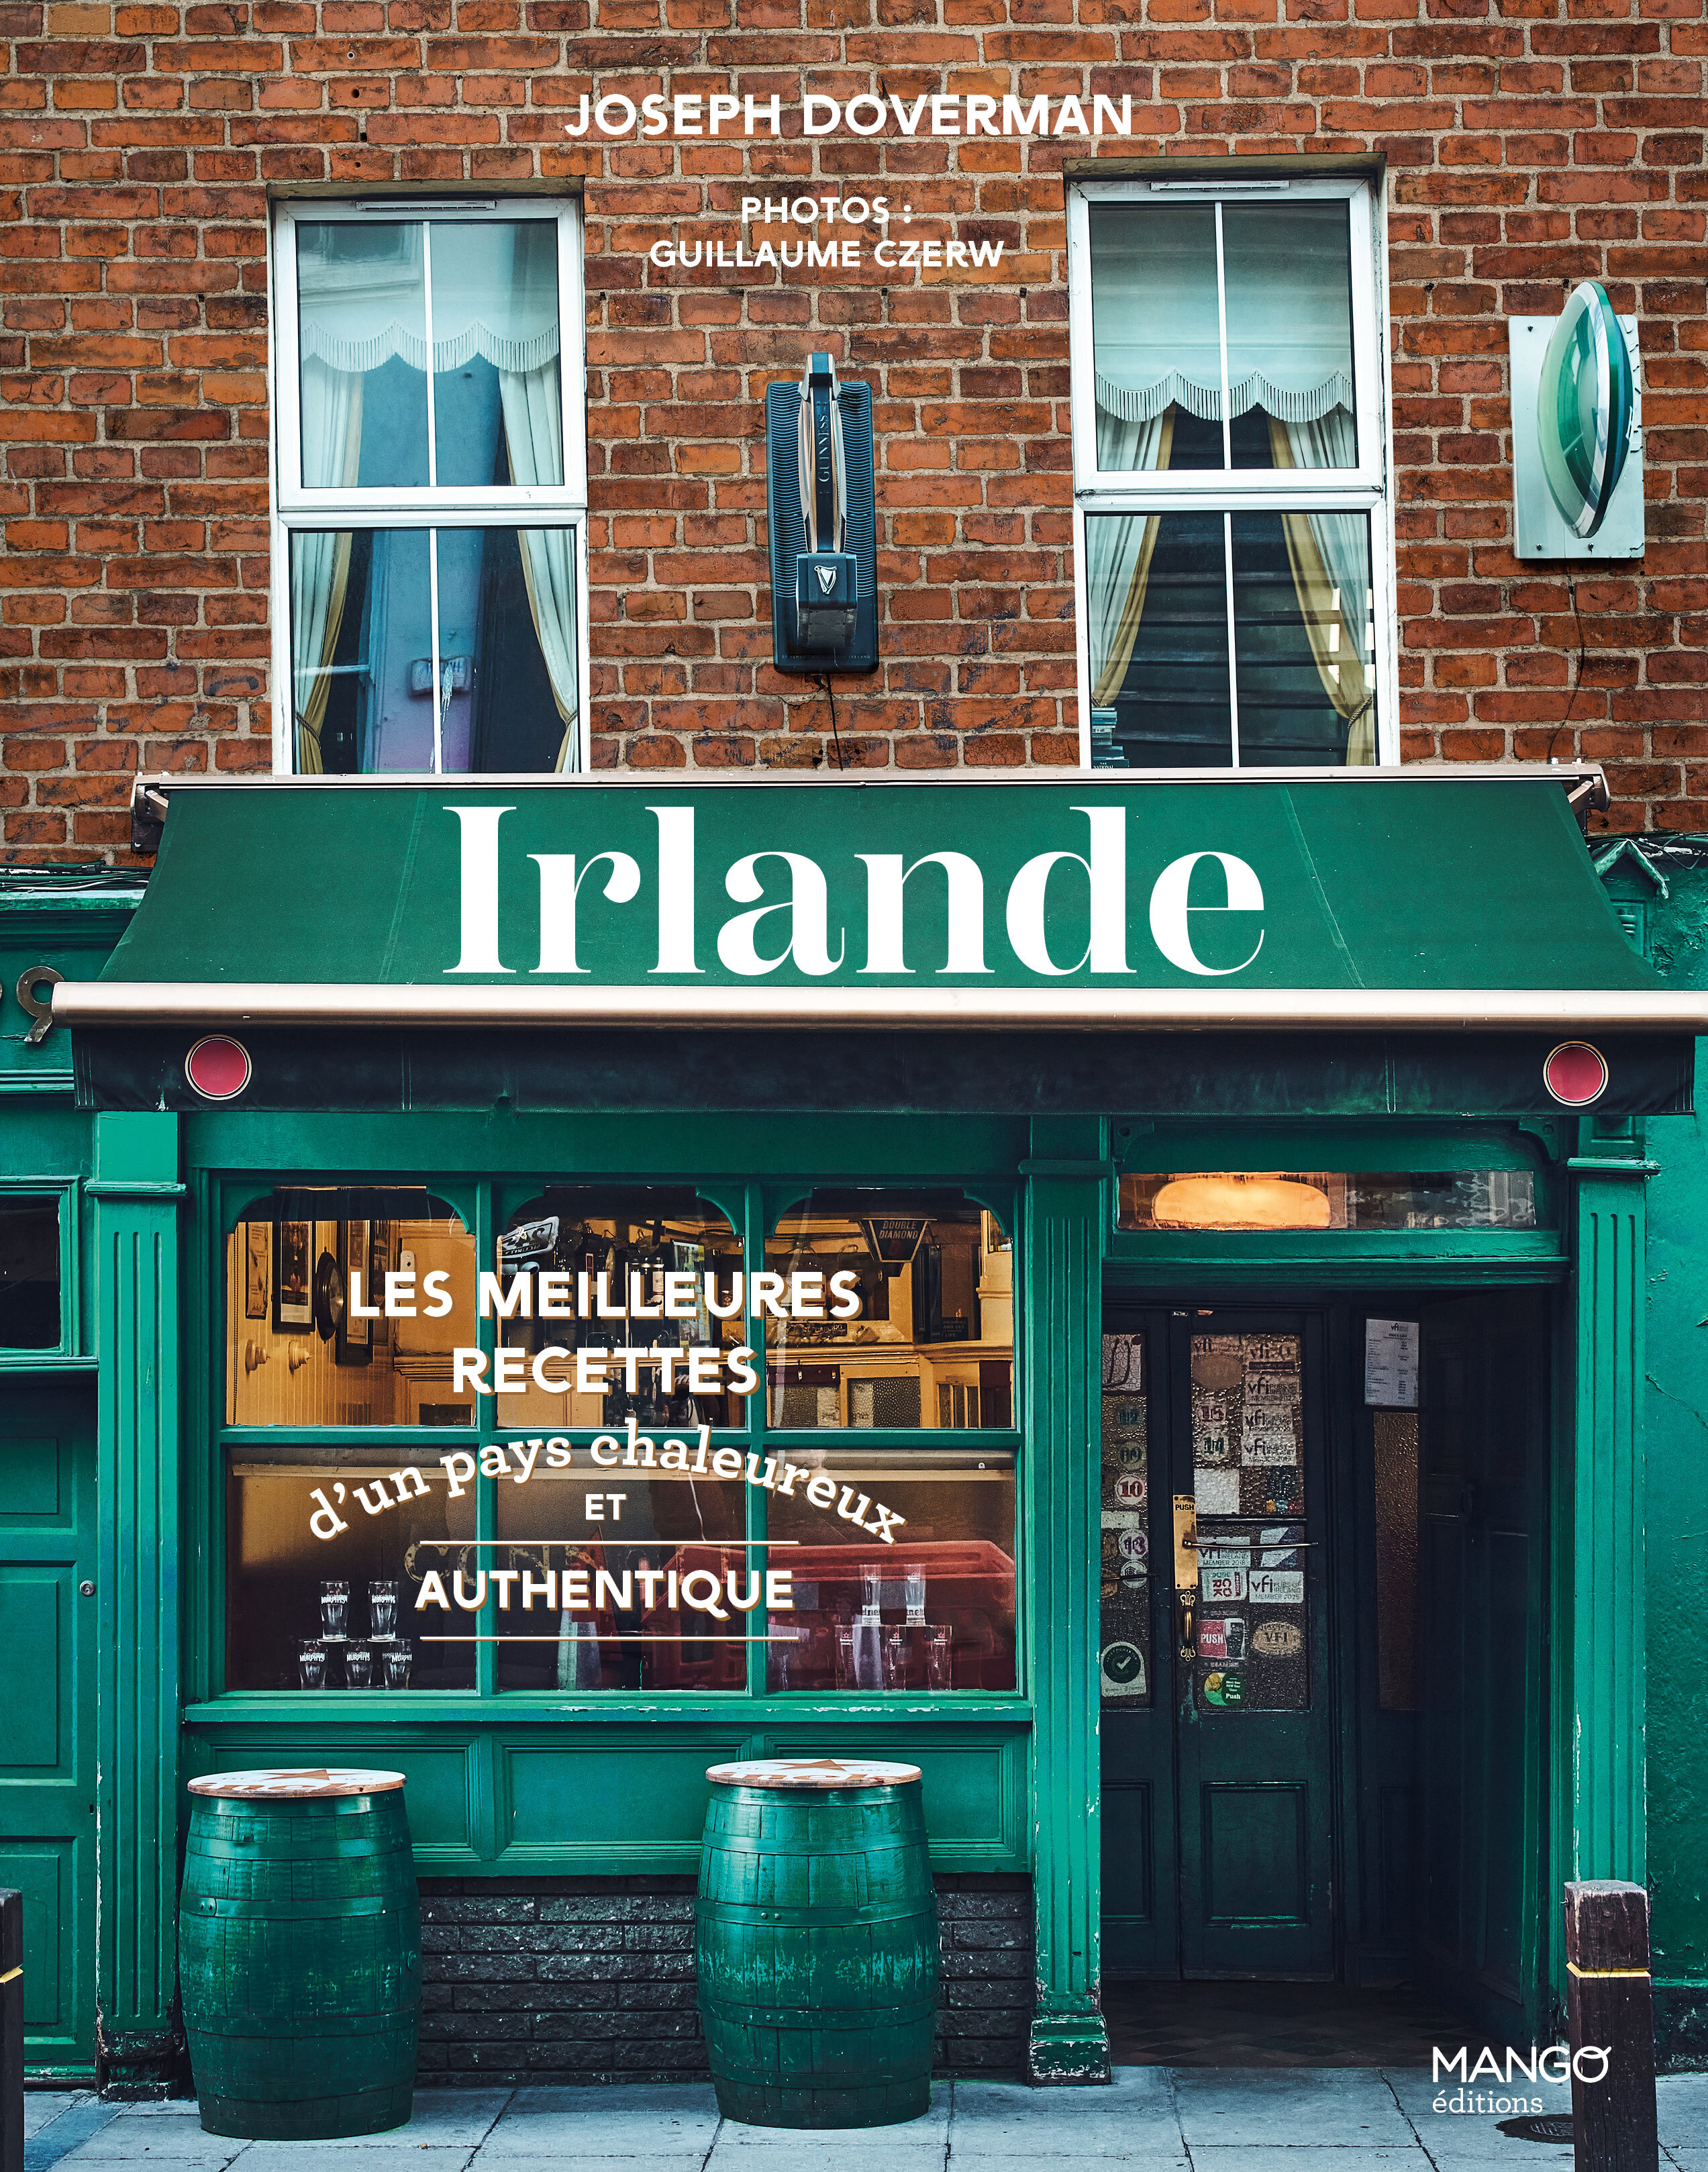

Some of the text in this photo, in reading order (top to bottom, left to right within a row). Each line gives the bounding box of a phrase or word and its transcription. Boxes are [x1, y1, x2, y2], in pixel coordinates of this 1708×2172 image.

[819, 415, 830, 482] GUINNESS
[0, 966, 64, 1042] 9
[883, 1221, 916, 1229] DOUBLE
[879, 1230, 918, 1238] DIAMOND
[1248, 1377, 1269, 1394] vfi
[1245, 1409, 1266, 1426] vfi
[1244, 1438, 1266, 1455] vfi
[1120, 1481, 1143, 1497] 10
[1251, 1575, 1272, 1593] vfi
[1201, 1634, 1223, 1644] PUSH
[1265, 1632, 1288, 1642] VFI
